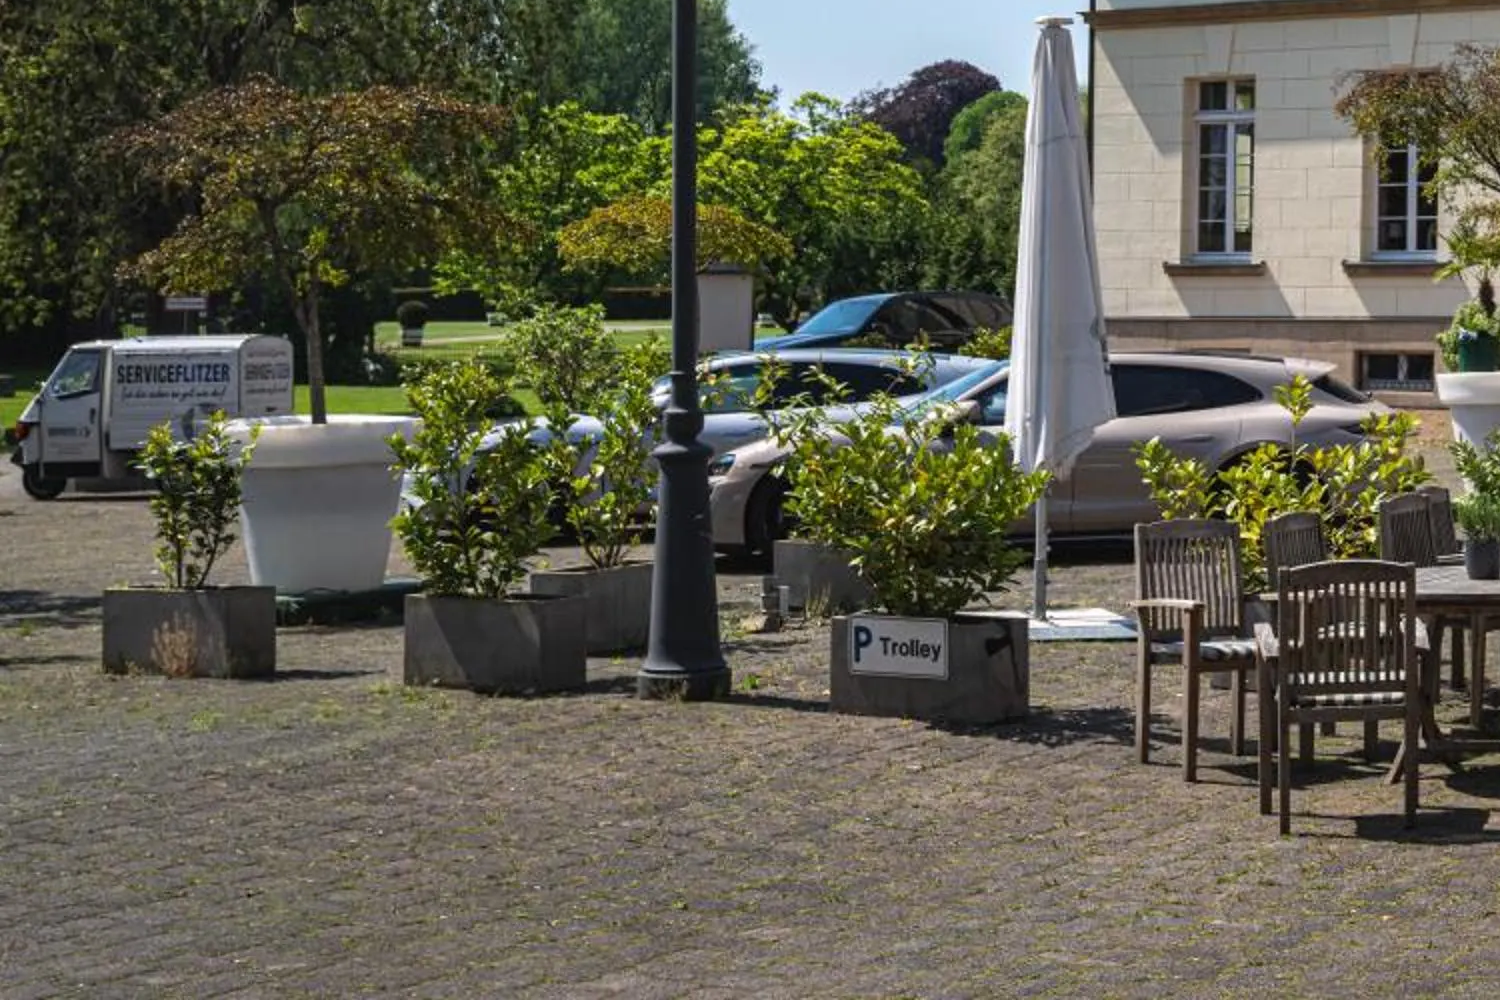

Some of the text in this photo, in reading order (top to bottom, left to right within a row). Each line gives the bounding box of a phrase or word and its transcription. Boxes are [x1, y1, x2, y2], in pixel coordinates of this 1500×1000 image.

[117, 363, 230, 384] SERVICEFLITZER
[854, 625, 942, 663] P Trolley
